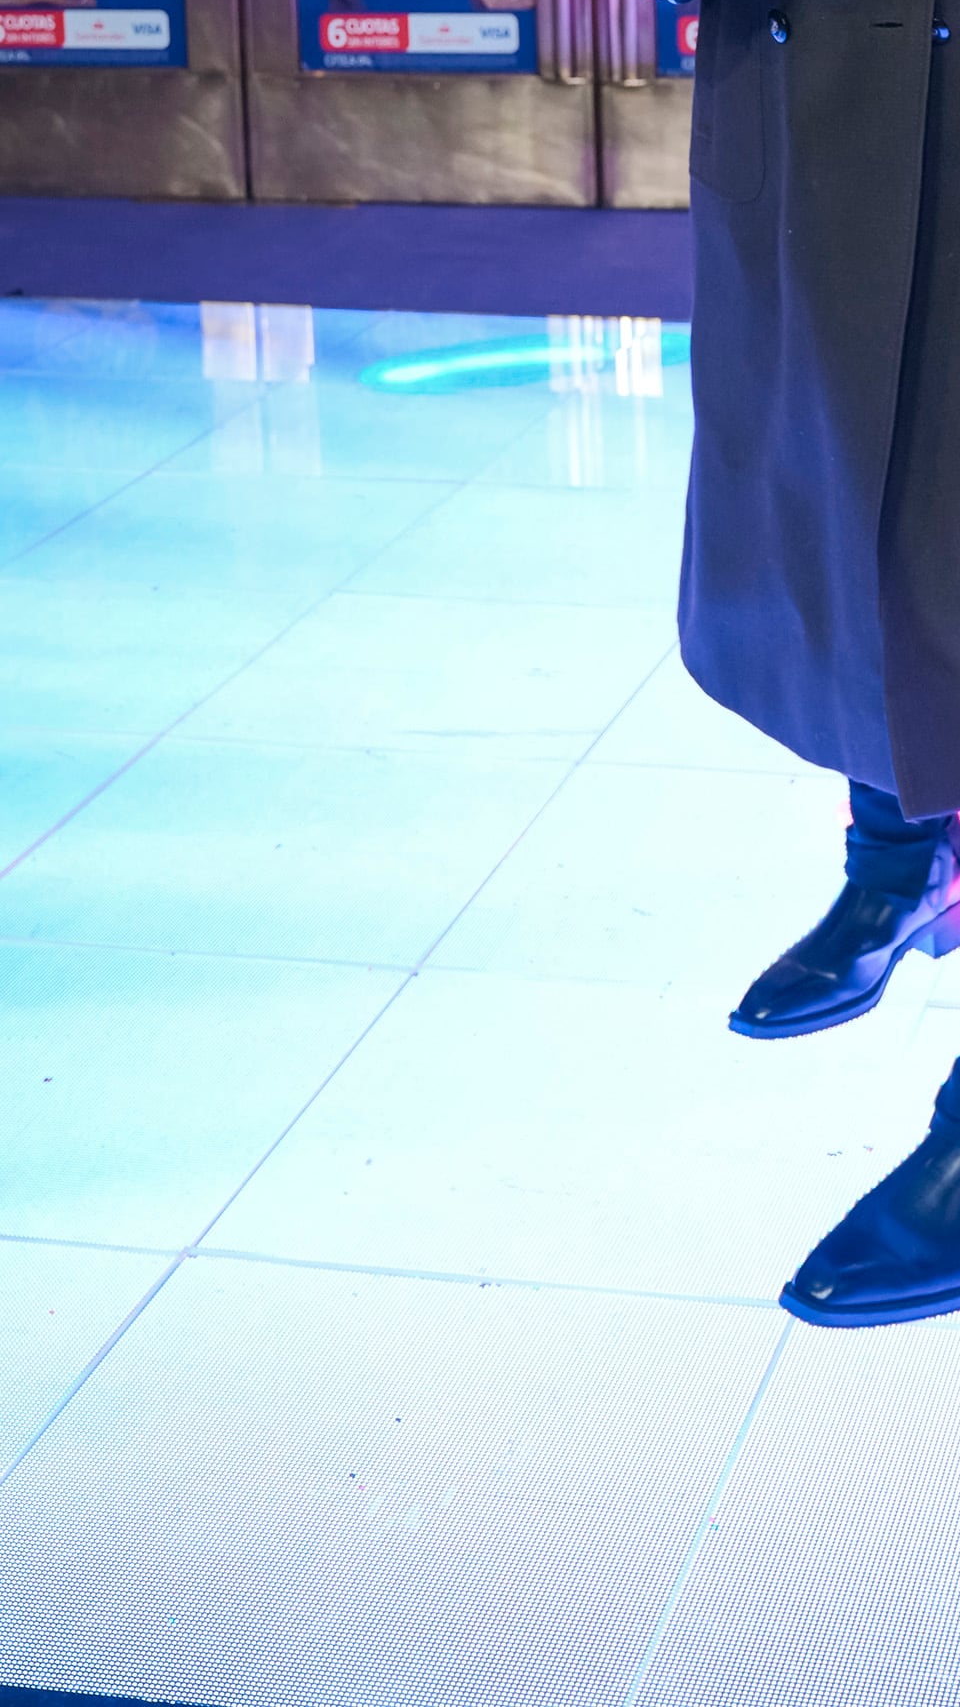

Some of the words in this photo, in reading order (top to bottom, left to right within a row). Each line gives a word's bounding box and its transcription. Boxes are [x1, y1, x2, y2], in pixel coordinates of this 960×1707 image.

[132, 24, 161, 35] VISA
[327, 18, 347, 49] 6
[346, 18, 399, 35] CUOTAS
[480, 27, 510, 38] VISA
